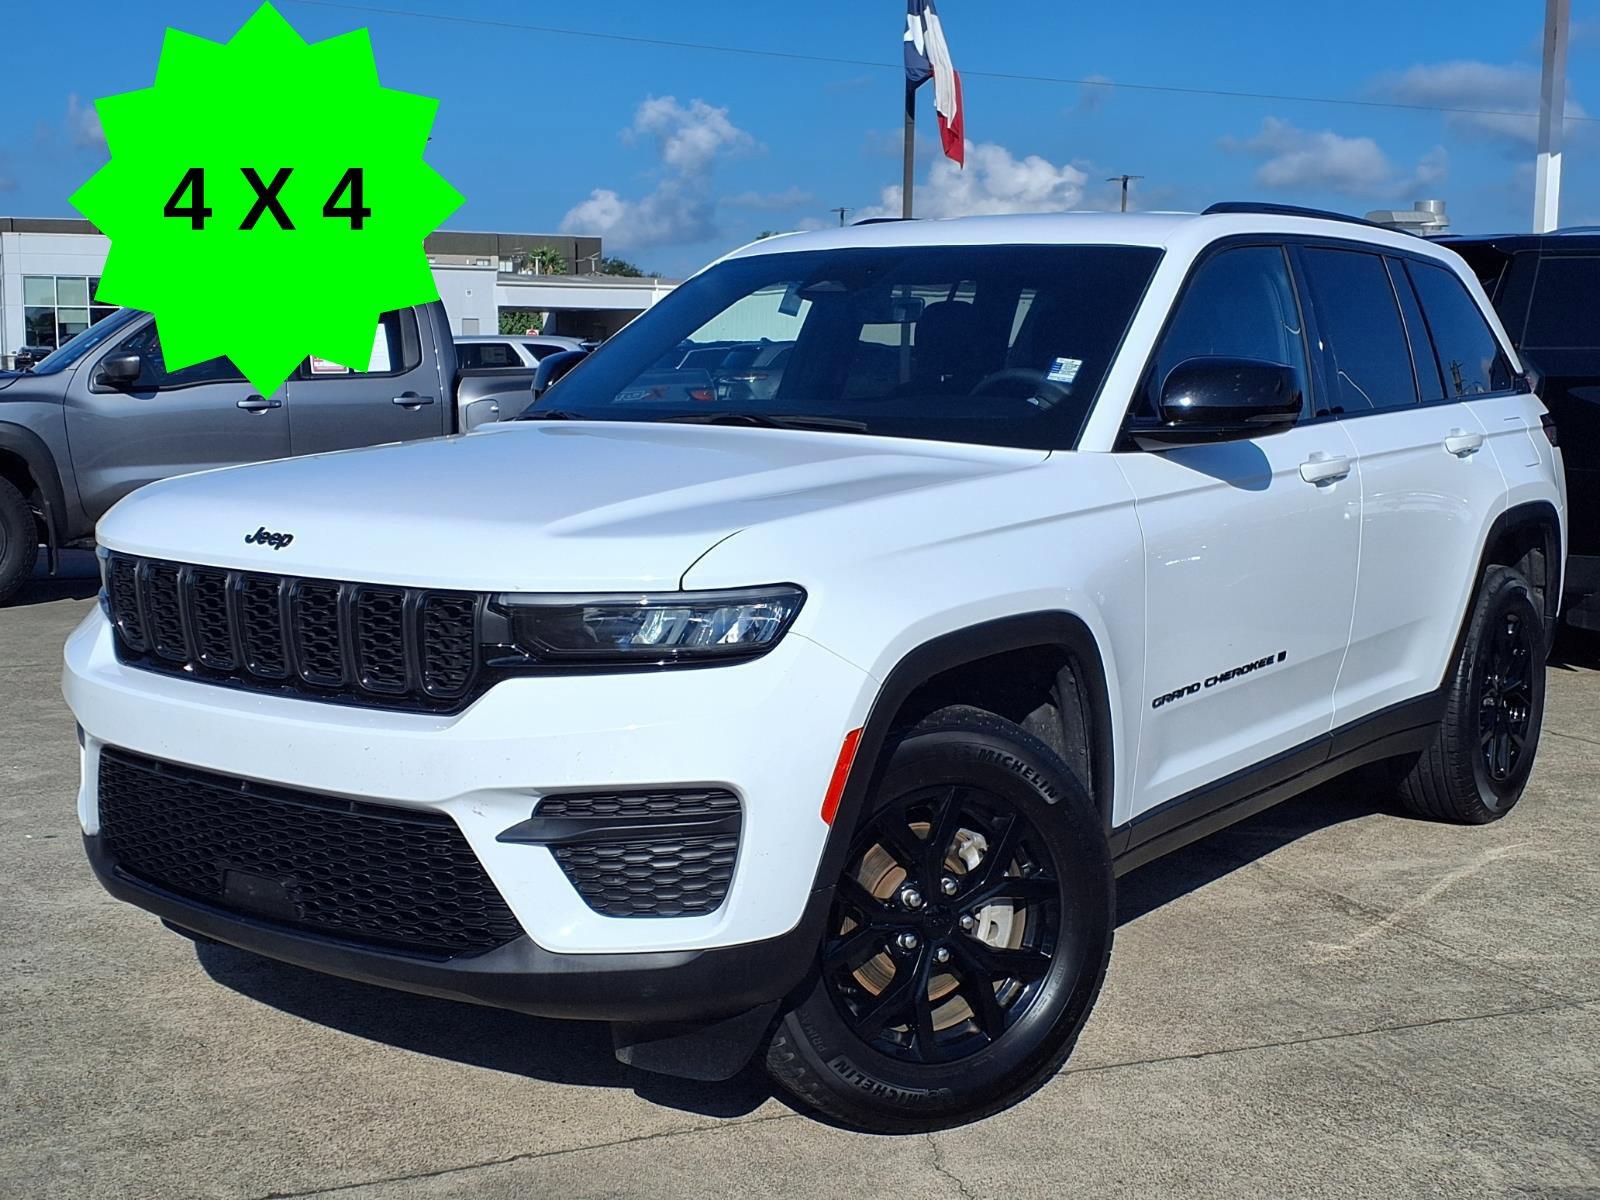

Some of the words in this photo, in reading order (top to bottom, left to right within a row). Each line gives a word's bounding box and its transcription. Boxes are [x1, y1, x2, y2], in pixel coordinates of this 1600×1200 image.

[244, 526, 294, 551] Jeep
[1151, 681, 1202, 709] GRAND
[1203, 655, 1275, 688] CHEROKEE
[977, 748, 1059, 801] MICHELIN
[833, 1059, 922, 1105] MICHELIN
